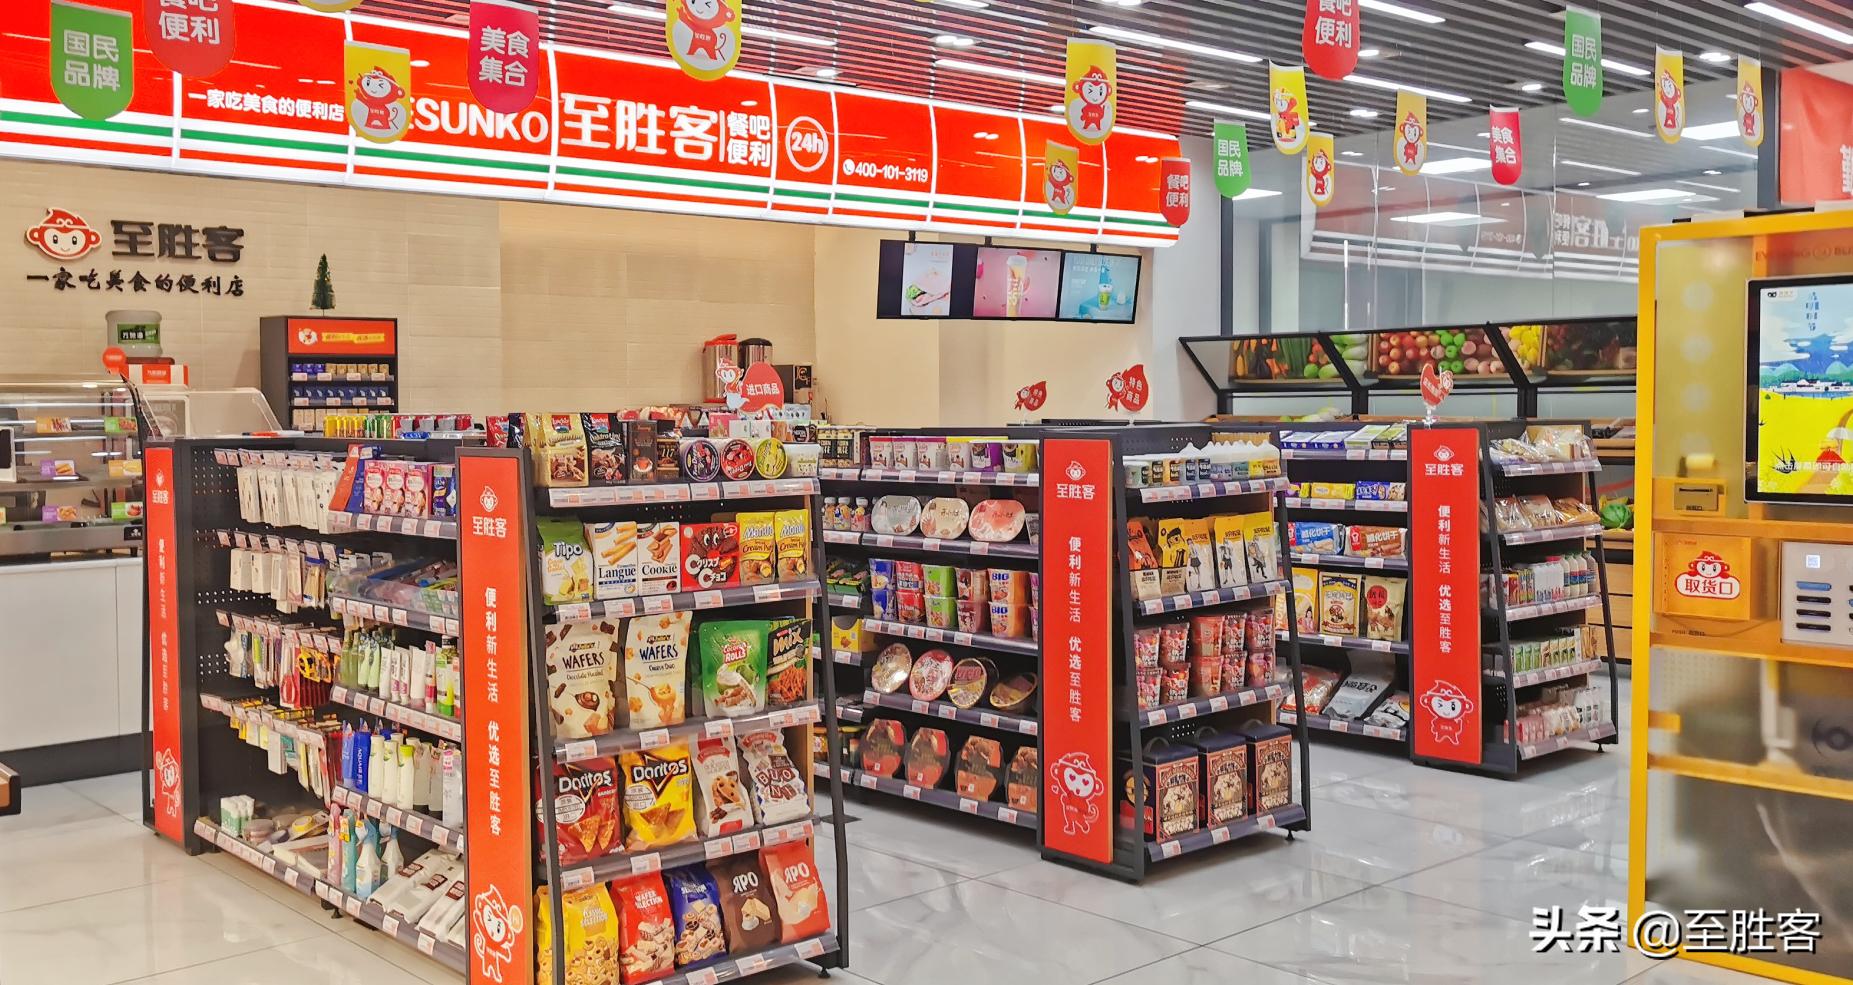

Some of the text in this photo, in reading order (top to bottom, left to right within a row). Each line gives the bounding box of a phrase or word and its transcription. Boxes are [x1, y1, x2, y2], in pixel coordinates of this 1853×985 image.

[159, 13, 221, 46] 便利
[1314, 17, 1353, 49] 便利
[63, 29, 120, 62] 国民
[481, 25, 530, 60] 美食
[1571, 33, 1597, 63] 国民
[63, 60, 121, 92] 品牌
[479, 55, 529, 88] 集合
[1570, 61, 1597, 90] 品牌
[188, 89, 345, 122] 一家吃美食的便利店
[408, 97, 549, 144] SUNKO
[560, 92, 720, 163] 至胜客
[727, 110, 771, 140] 餐吧
[789, 131, 824, 154] 24h
[1491, 125, 1514, 145] 美食
[726, 138, 771, 168] 便利
[1217, 139, 1241, 158] 国民
[1494, 144, 1517, 166] 集合
[855, 163, 929, 184] 400-101-3119
[1217, 158, 1243, 179] 品牌
[1166, 174, 1189, 191] 餐吧
[1166, 190, 1189, 209] 便利
[110, 219, 246, 264] 至胜客
[26, 266, 245, 298] 一家吃美食的便利店
[746, 382, 780, 396] 进口商品
[1425, 463, 1464, 477] 至胜客
[1056, 483, 1096, 501] 至胜客
[472, 516, 507, 538] 至胜客
[553, 541, 584, 560] Tipo
[1437, 504, 1451, 575] 便利新生活
[598, 566, 637, 580] Langue
[641, 565, 678, 576] Cookie
[1068, 536, 1082, 623] 便利新生活
[1685, 578, 1734, 596] 取货口
[1439, 584, 1452, 654] 优选至胜客
[484, 587, 499, 704] 便利新生活
[639, 644, 679, 661] WAFERS
[725, 648, 746, 662] ROLLS
[562, 652, 605, 670] WAFERS
[1069, 636, 1082, 722] 优选至胜客
[487, 720, 502, 836] 优选至胜客
[559, 770, 612, 793] Doritos
[633, 759, 688, 782] Doritos
[635, 889, 657, 902] WAFER
